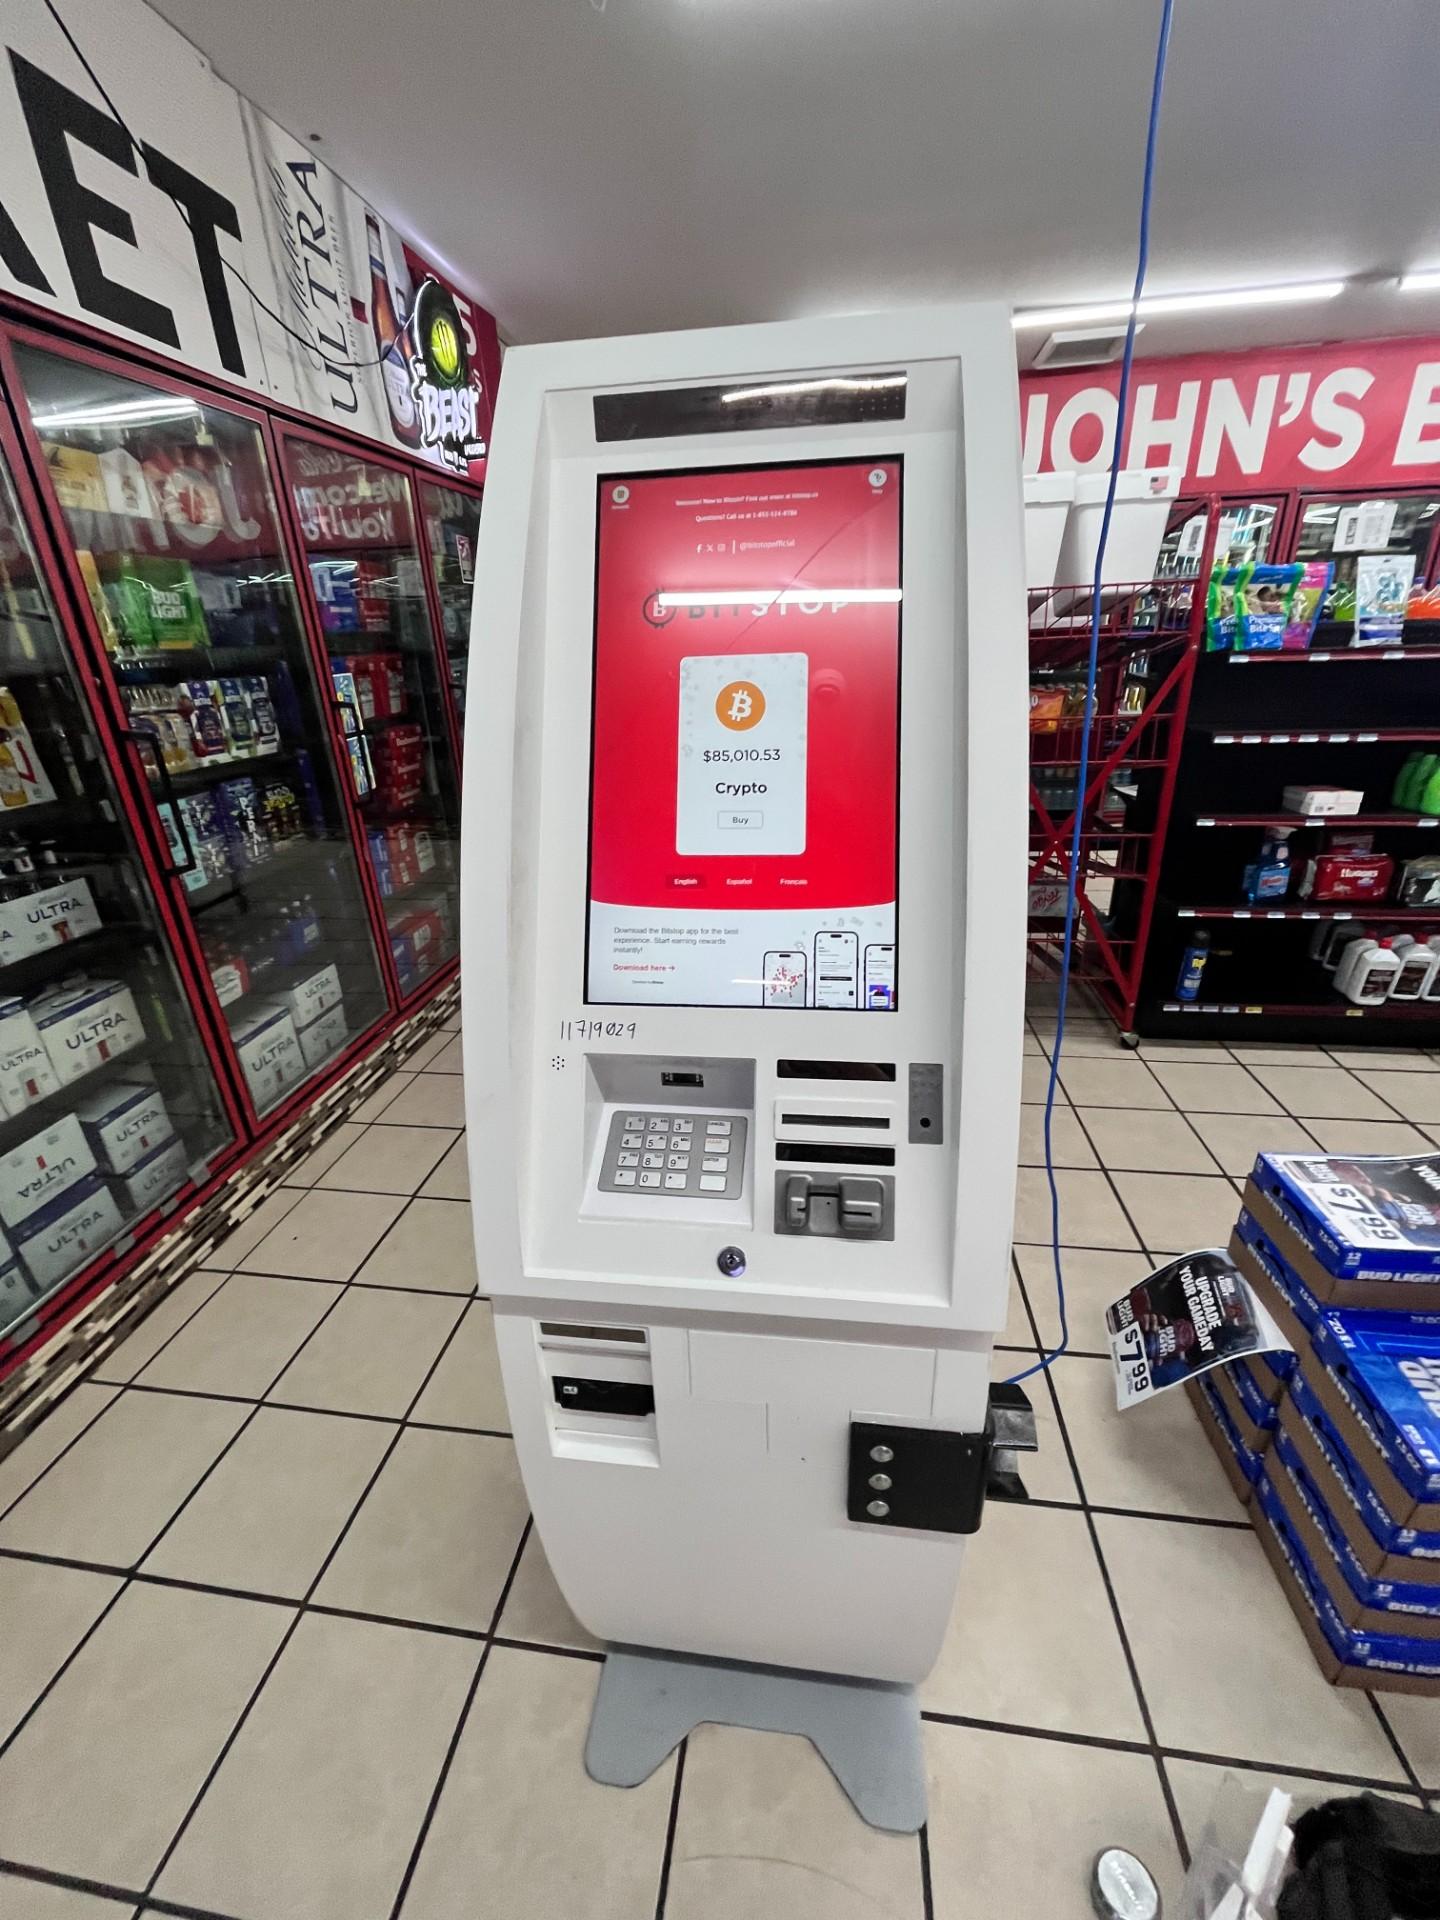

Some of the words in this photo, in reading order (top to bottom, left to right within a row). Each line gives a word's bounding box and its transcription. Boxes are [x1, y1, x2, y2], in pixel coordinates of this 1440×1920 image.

[287, 160, 360, 414] ULTRA
[419, 380, 480, 443] BEAST
[703, 749, 781, 763] $85,010.53
[715, 782, 768, 796] Crypto
[732, 816, 749, 825] Buy
[26, 897, 84, 924] ULTRA
[671, 938, 697, 946] earning
[685, 928, 699, 936] app
[700, 927, 710, 935] for
[65, 1012, 127, 1050] ULTRA
[560, 1019, 637, 1041] 11719029
[1, 1046, 43, 1072] ULTRA
[251, 1036, 295, 1073] ULTRA
[116, 1110, 161, 1143] ULTRA
[17, 1156, 77, 1199] ULTRA
[47, 1211, 105, 1253] ULTRA
[1178, 1265, 1198, 1297] YOUR
[1357, 1270, 1392, 1280] BUD
[1123, 1298, 1134, 1323] BUD
[1195, 1276, 1222, 1331] UPGRADE
[1187, 1295, 1214, 1352] GAMEDAY
[1165, 1325, 1177, 1353] BUD
